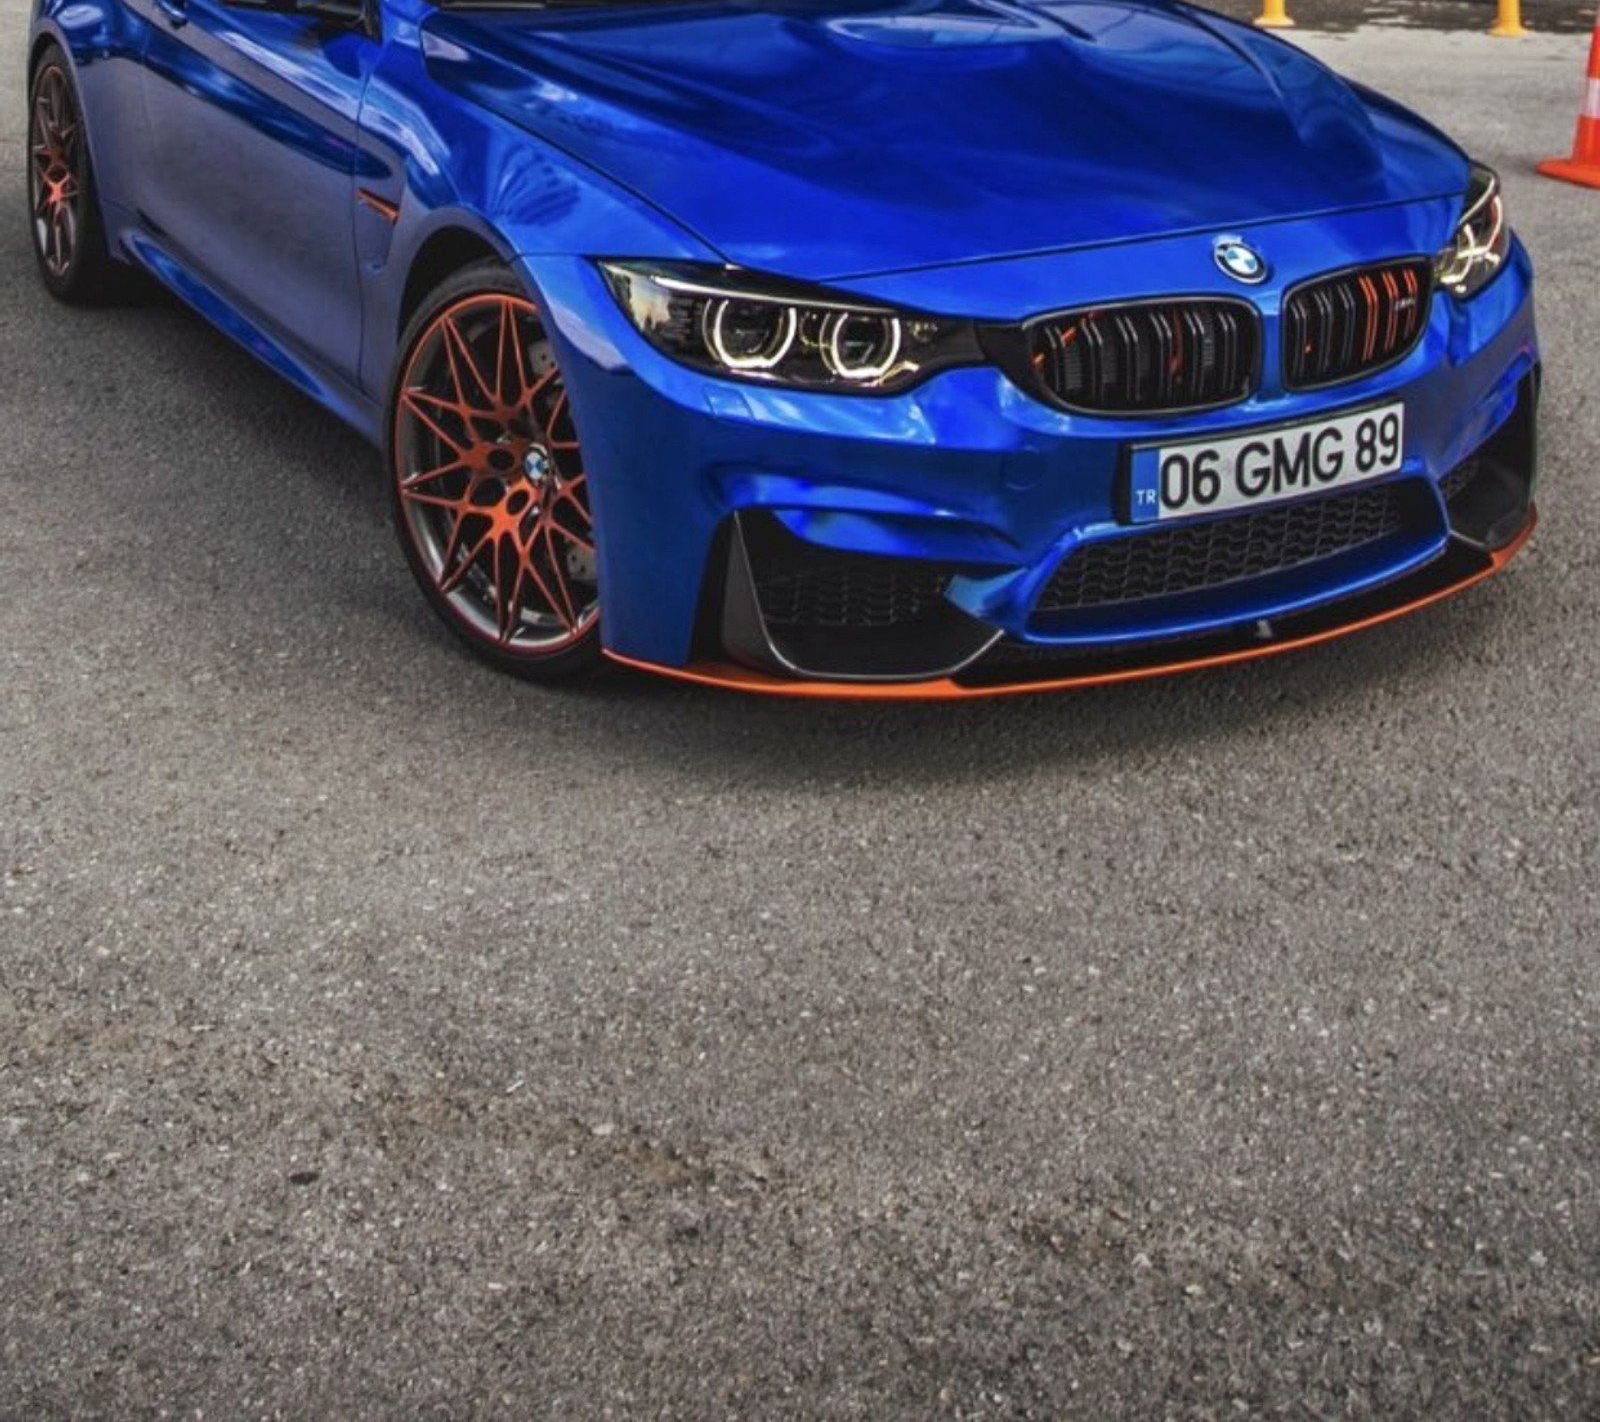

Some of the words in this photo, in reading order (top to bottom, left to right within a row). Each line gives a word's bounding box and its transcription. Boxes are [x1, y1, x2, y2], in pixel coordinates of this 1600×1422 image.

[1161, 449, 1221, 509] 06
[1235, 427, 1345, 497] GMG
[1355, 412, 1400, 473] 89
[1136, 489, 1157, 505] TR
